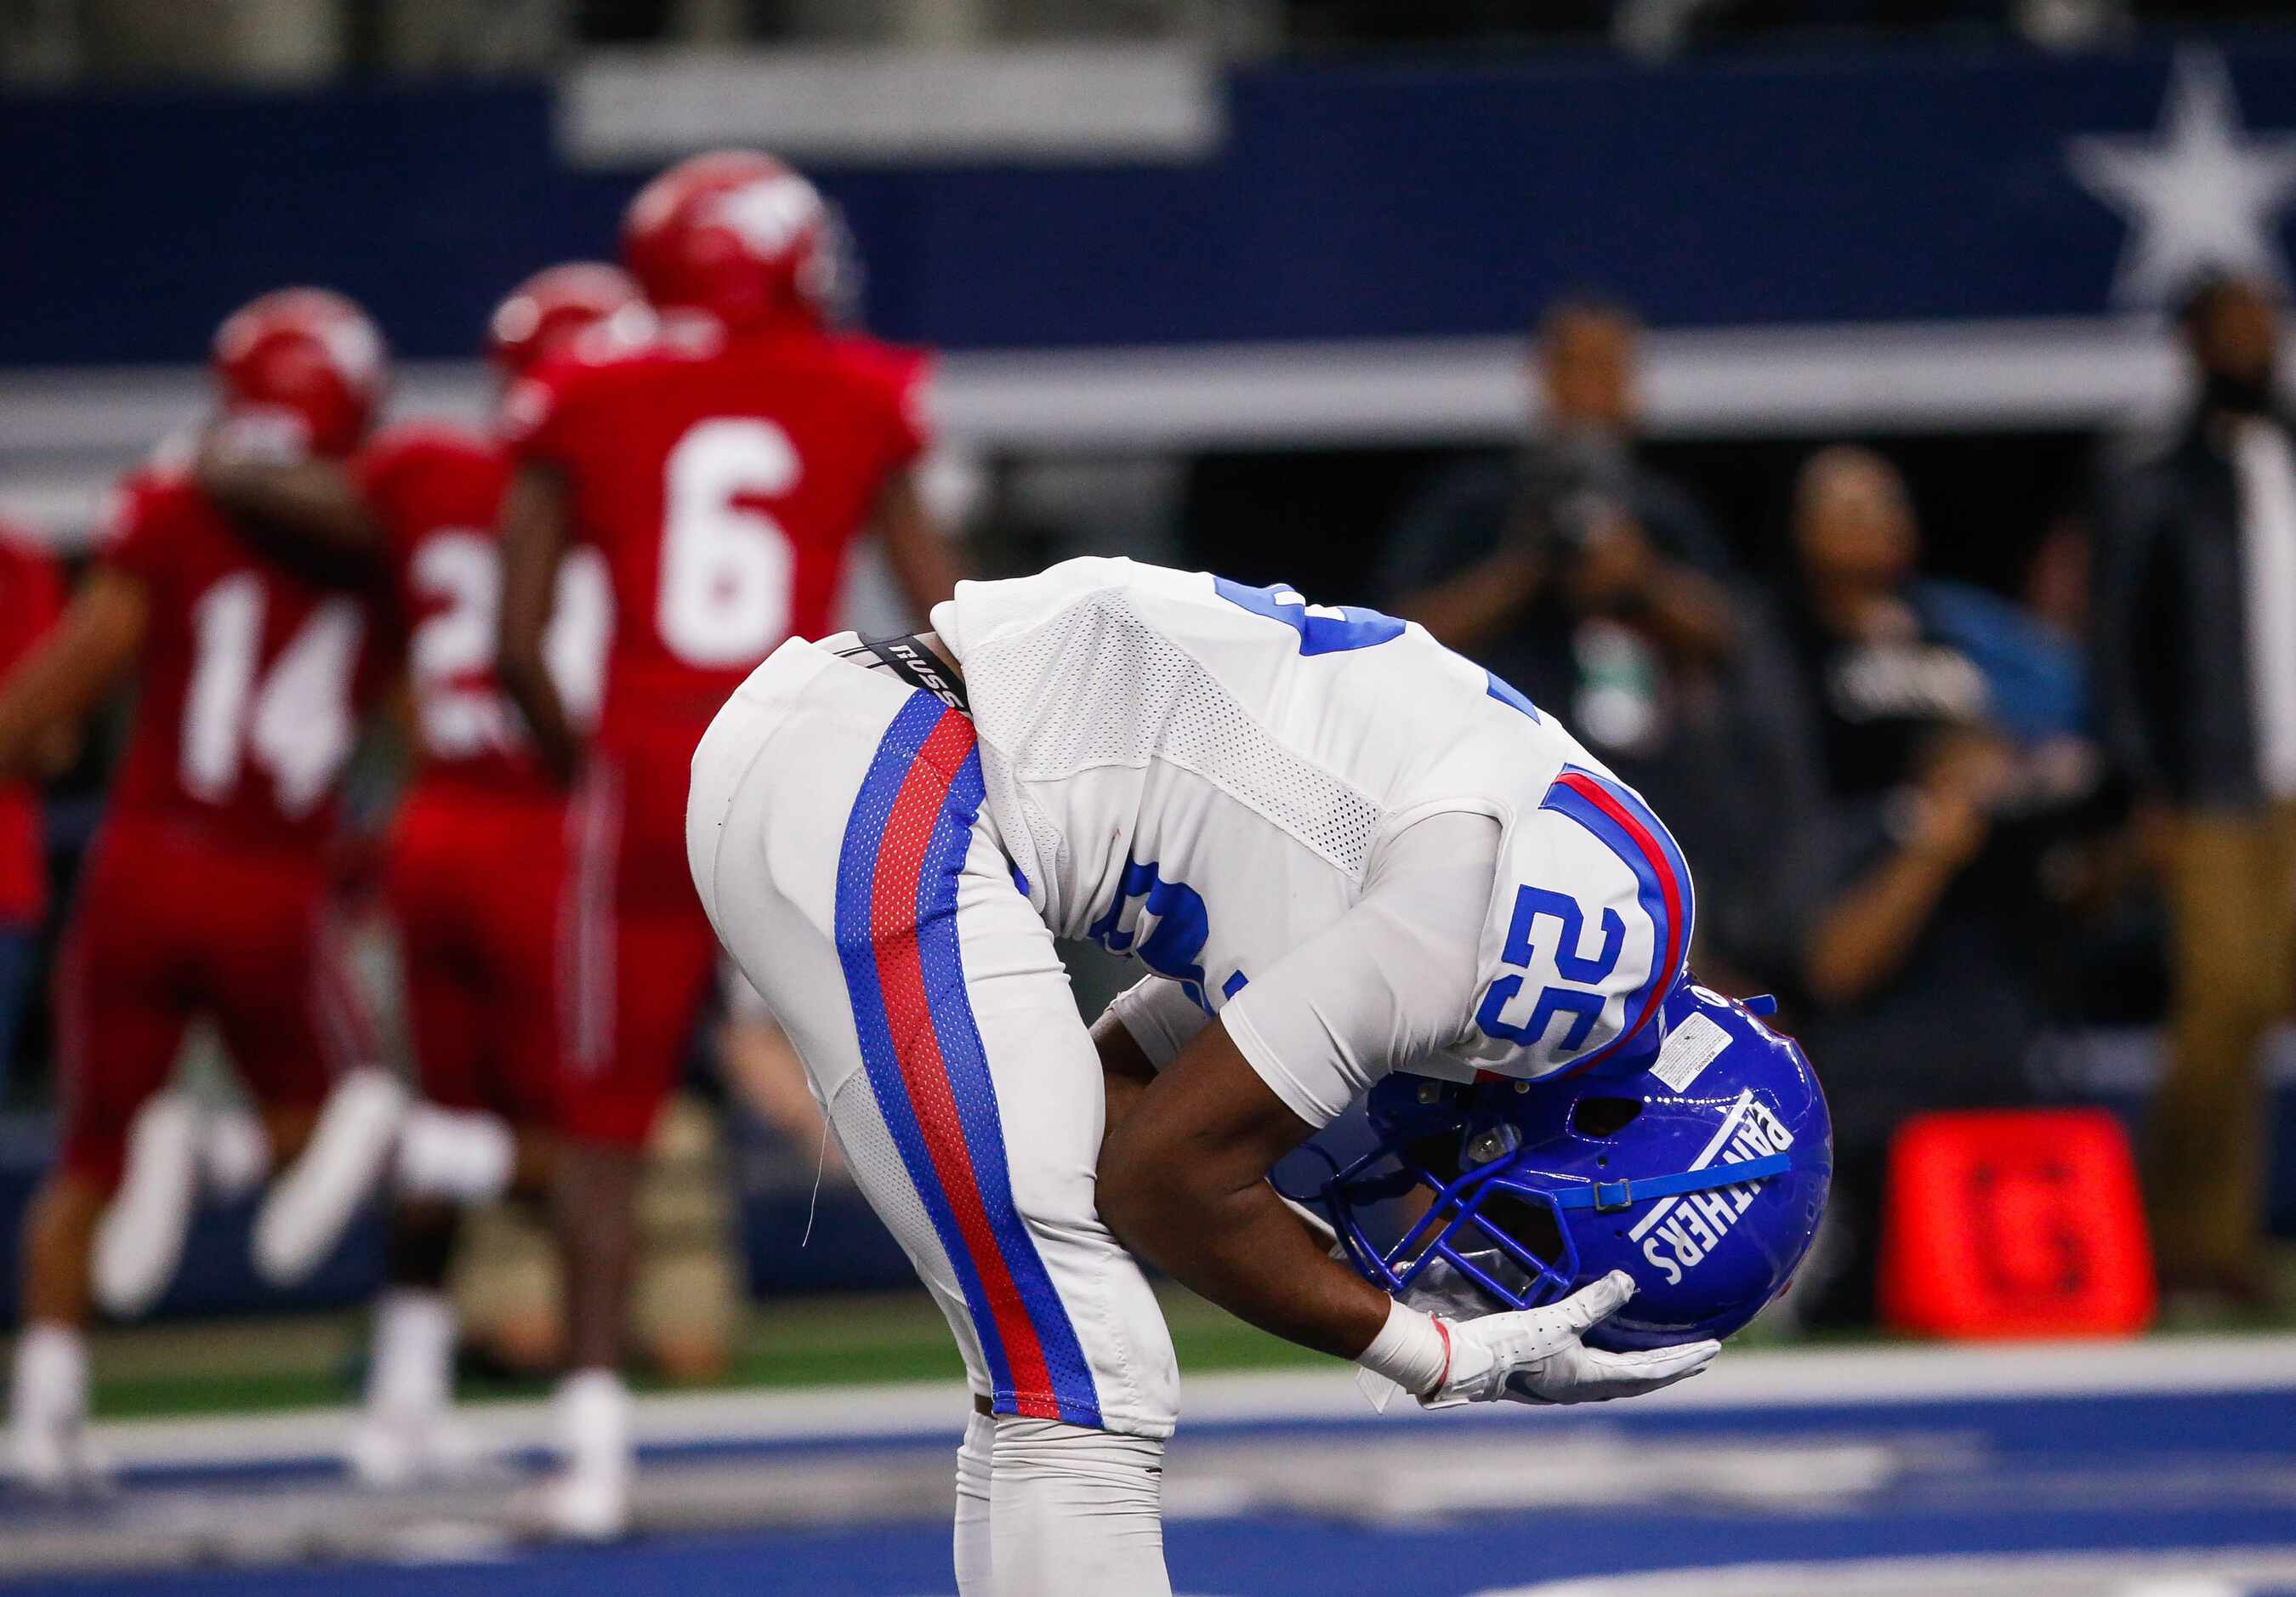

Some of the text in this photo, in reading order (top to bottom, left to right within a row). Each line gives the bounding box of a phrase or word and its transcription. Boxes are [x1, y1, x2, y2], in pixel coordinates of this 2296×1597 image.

[660, 415, 802, 668] 6
[179, 570, 364, 820] 14
[1475, 884, 1627, 1052] 25
